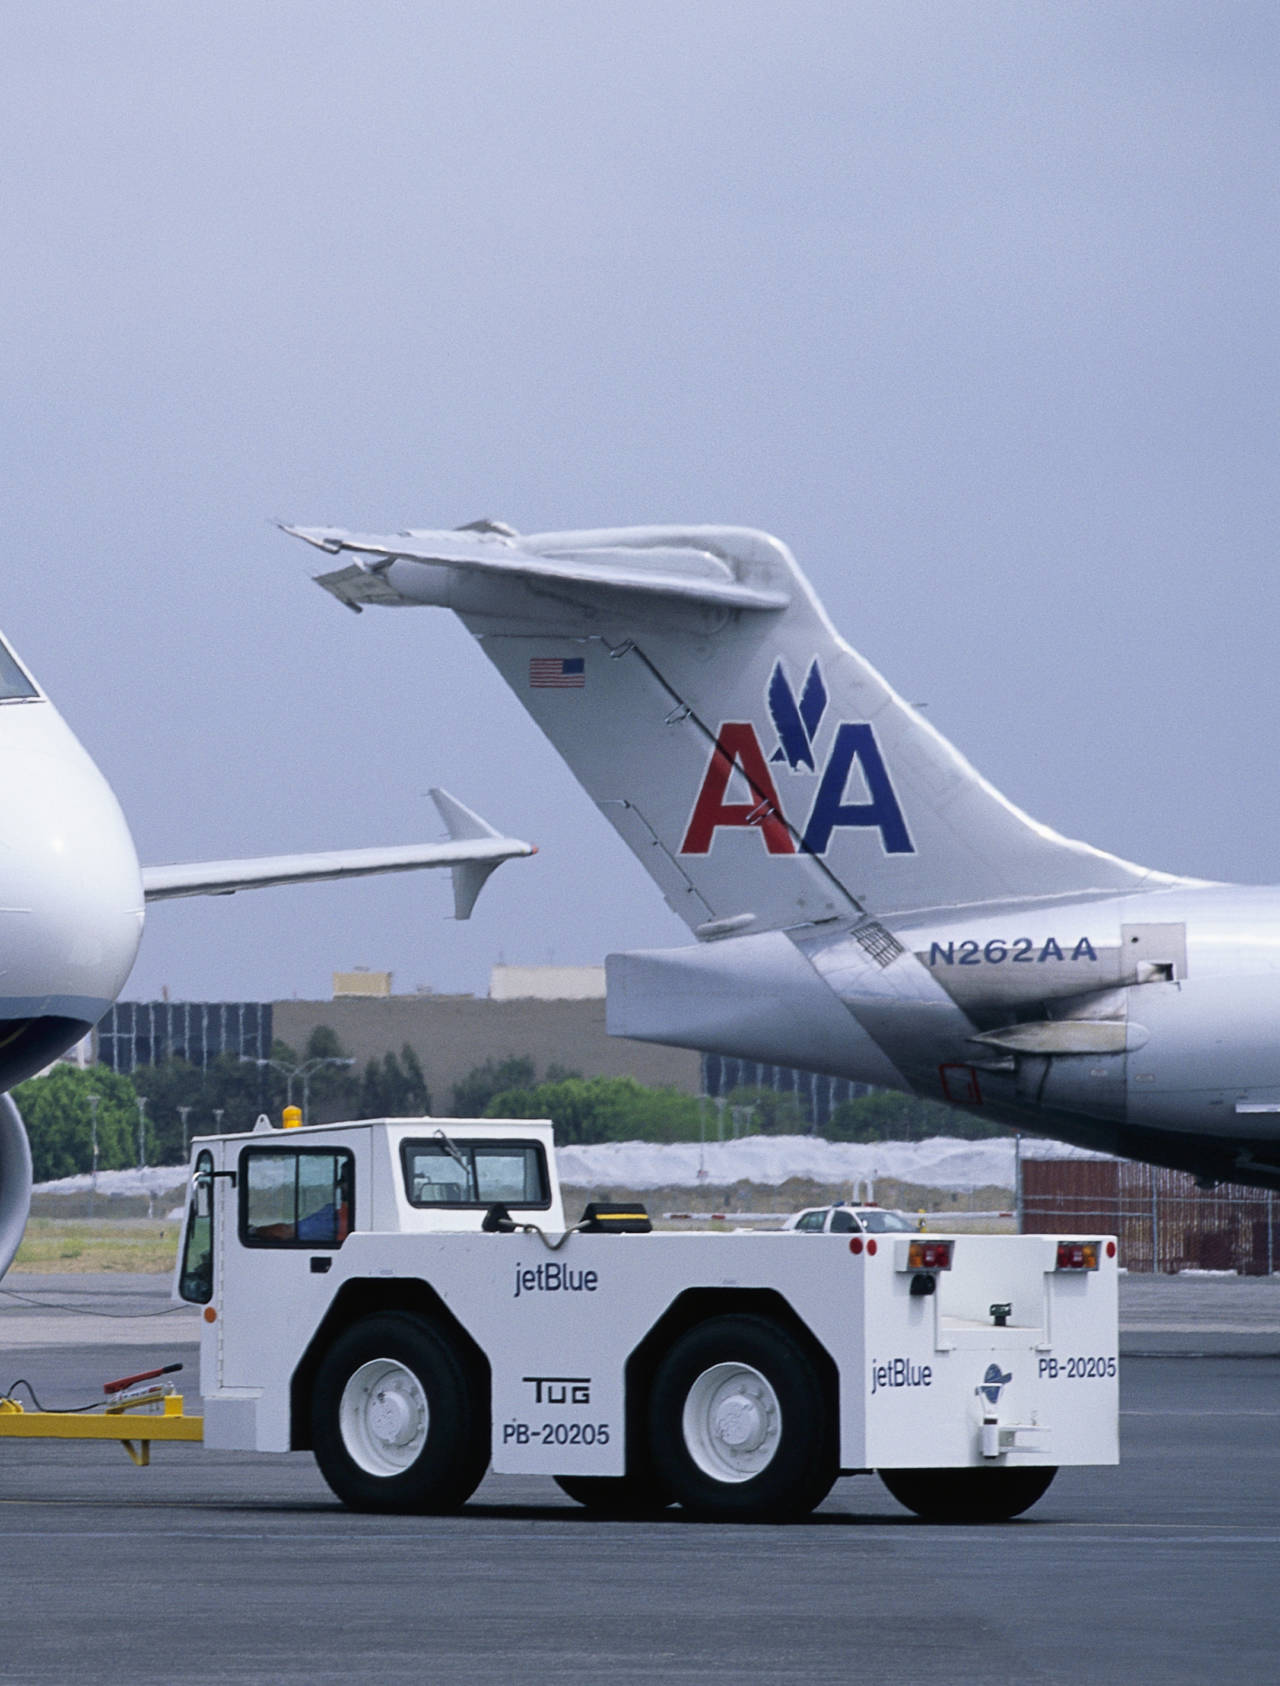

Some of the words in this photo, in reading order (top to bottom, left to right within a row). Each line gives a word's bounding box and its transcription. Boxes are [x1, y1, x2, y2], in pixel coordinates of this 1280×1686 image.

[680, 722, 915, 855] AA
[929, 936, 1098, 966] N262AA
[514, 1262, 598, 1298] jetBlue
[872, 1357, 932, 1395] jetBlue
[1038, 1357, 1117, 1379] PB-20205
[522, 1377, 591, 1405] TUG
[503, 1423, 610, 1446] PB-20205
